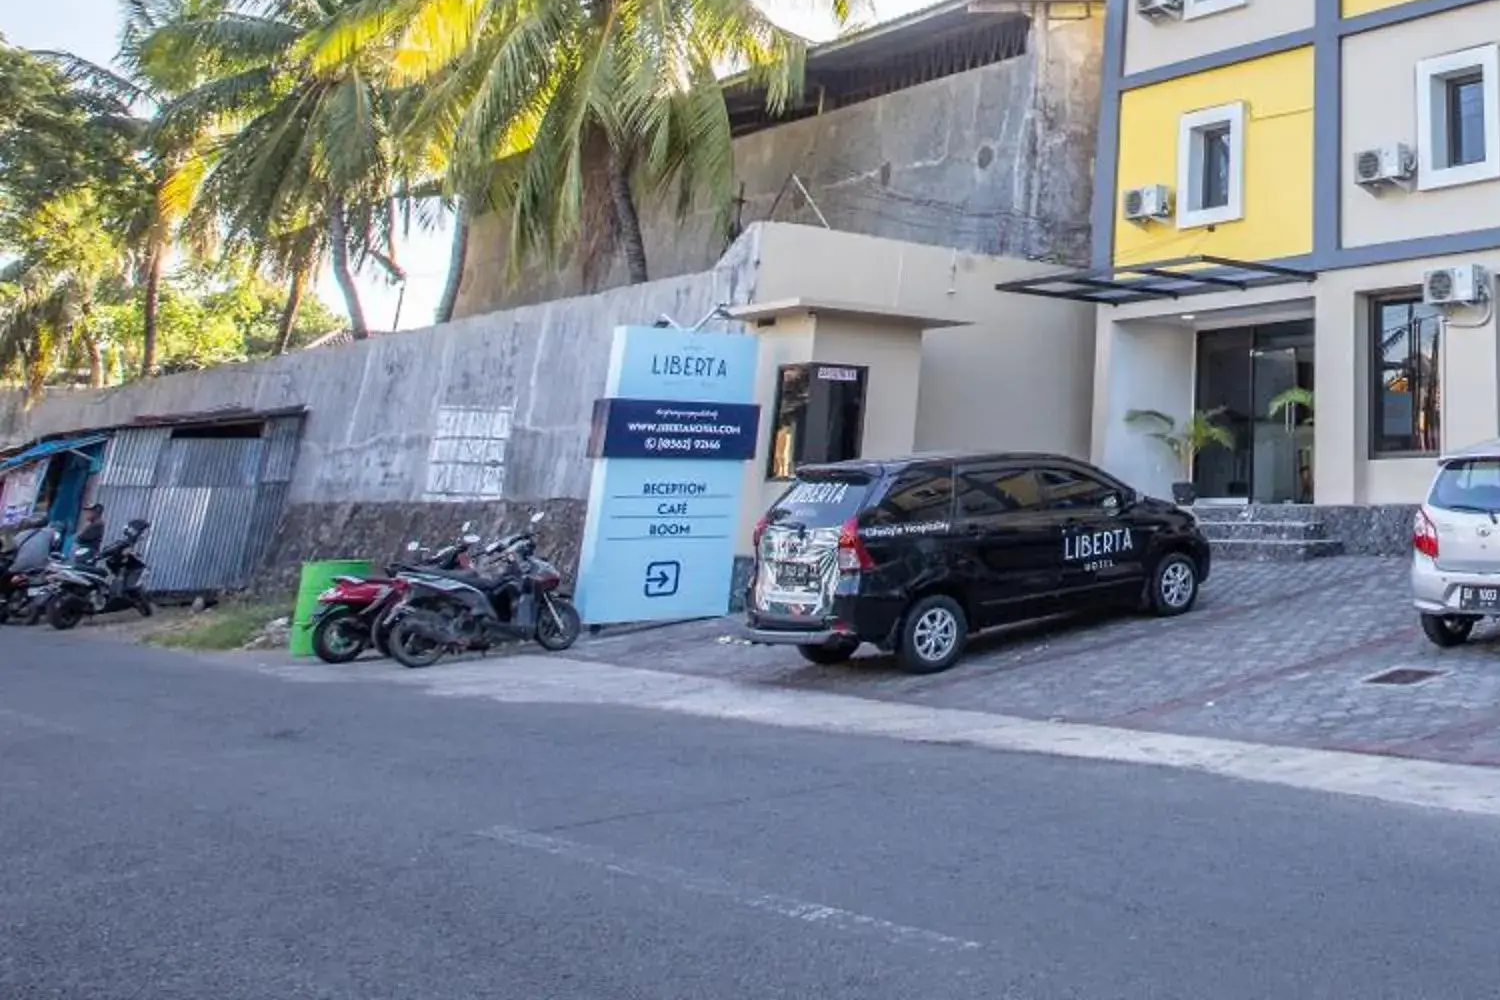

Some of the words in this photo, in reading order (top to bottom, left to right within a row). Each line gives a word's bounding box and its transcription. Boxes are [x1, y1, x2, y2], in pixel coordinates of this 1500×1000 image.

[652, 354, 727, 377] LIBERTA
[643, 482, 707, 494] RECEPTION
[789, 483, 849, 503] LIBERTA
[657, 502, 688, 515] CAFÉ
[650, 523, 691, 535] ROOM
[1064, 527, 1133, 560] LIBERTA
